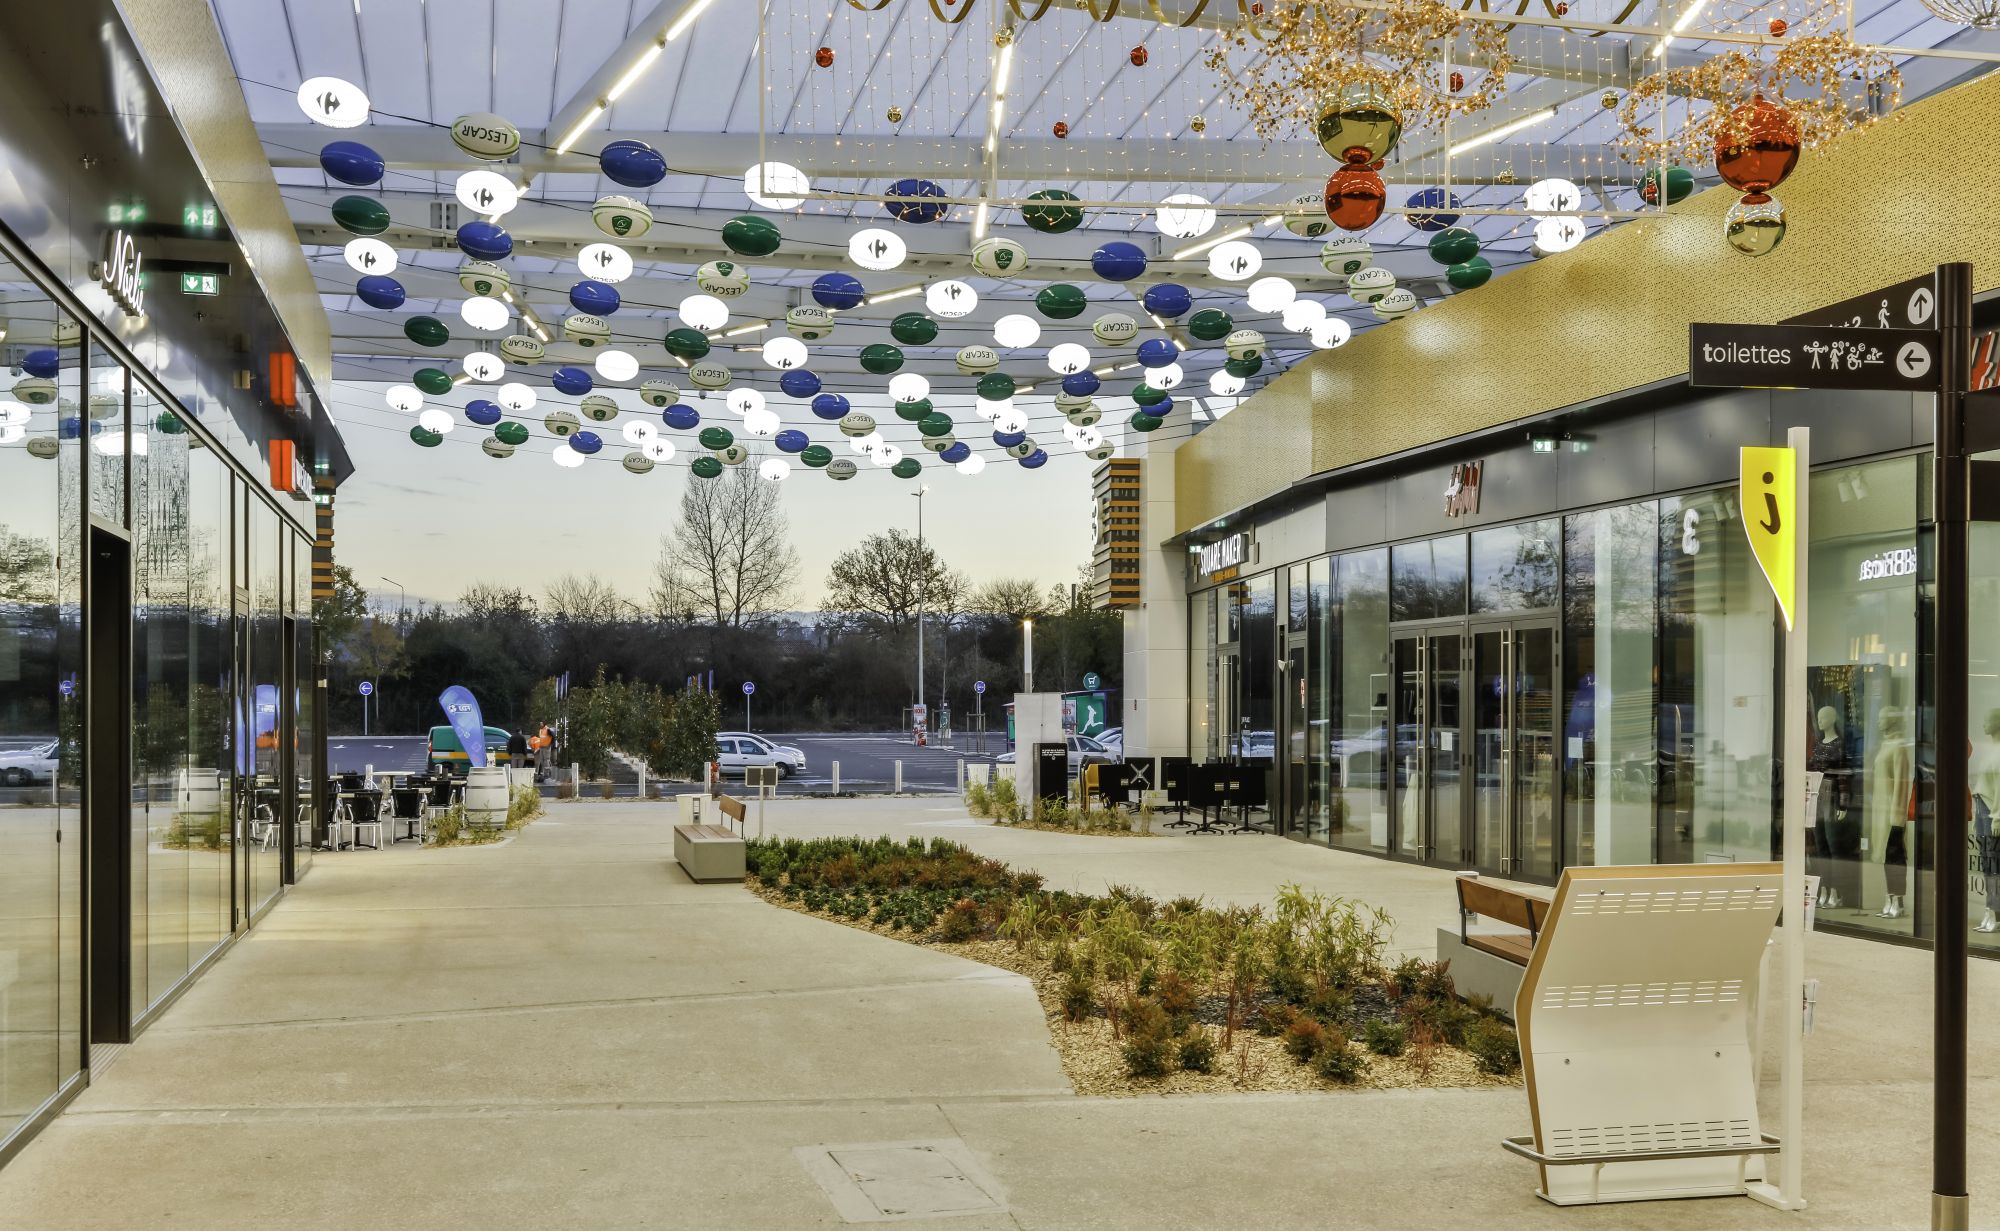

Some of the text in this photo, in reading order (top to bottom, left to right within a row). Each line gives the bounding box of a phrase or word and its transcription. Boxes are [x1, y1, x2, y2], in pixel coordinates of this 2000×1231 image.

[462, 125, 508, 145] LESCAR
[704, 283, 741, 295] LESCAR
[1384, 294, 1413, 305] LESCAR
[795, 308, 828, 319] LESCAR
[1102, 322, 1133, 332] LESCAR
[508, 339, 538, 351] LESCAR
[965, 351, 994, 359] LESCAR
[1703, 342, 1791, 364] toilettes
[696, 369, 725, 379] LESCAR
[1221, 533, 1242, 571] MAKER
